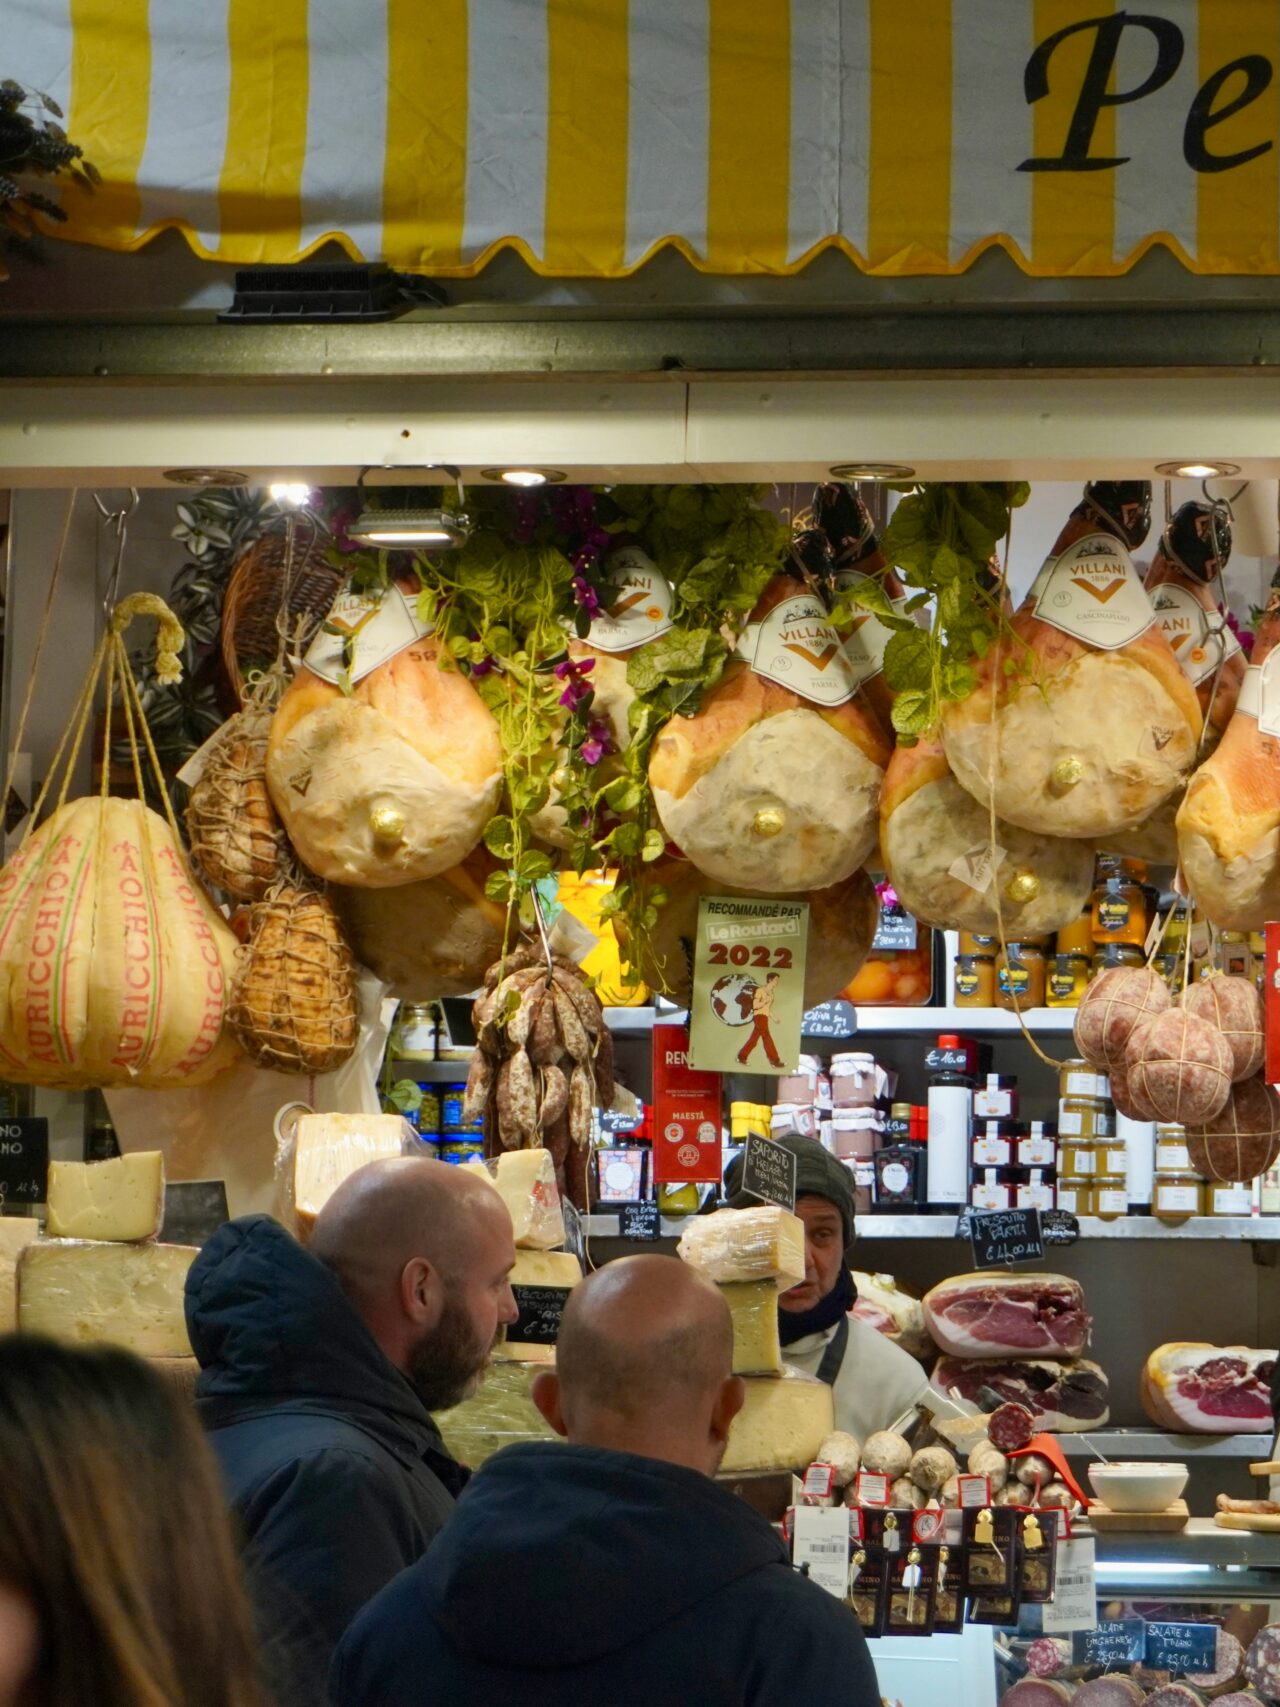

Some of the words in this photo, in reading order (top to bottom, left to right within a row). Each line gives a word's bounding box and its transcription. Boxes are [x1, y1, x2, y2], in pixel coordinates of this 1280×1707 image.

[1070, 563, 1126, 576] VILLANI
[611, 576, 652, 589] LANI
[805, 639, 824, 647] 1886
[811, 681, 838, 689] PARMA
[707, 902, 779, 917] RECOMMANDÉ
[780, 907, 802, 919] PAR
[707, 943, 792, 969] 2022
[26, 871, 70, 1065] AURICCHIO
[111, 877, 151, 1067] AURICCHIO
[925, 1051, 940, 1066] €
[941, 1052, 967, 1063] 16.00
